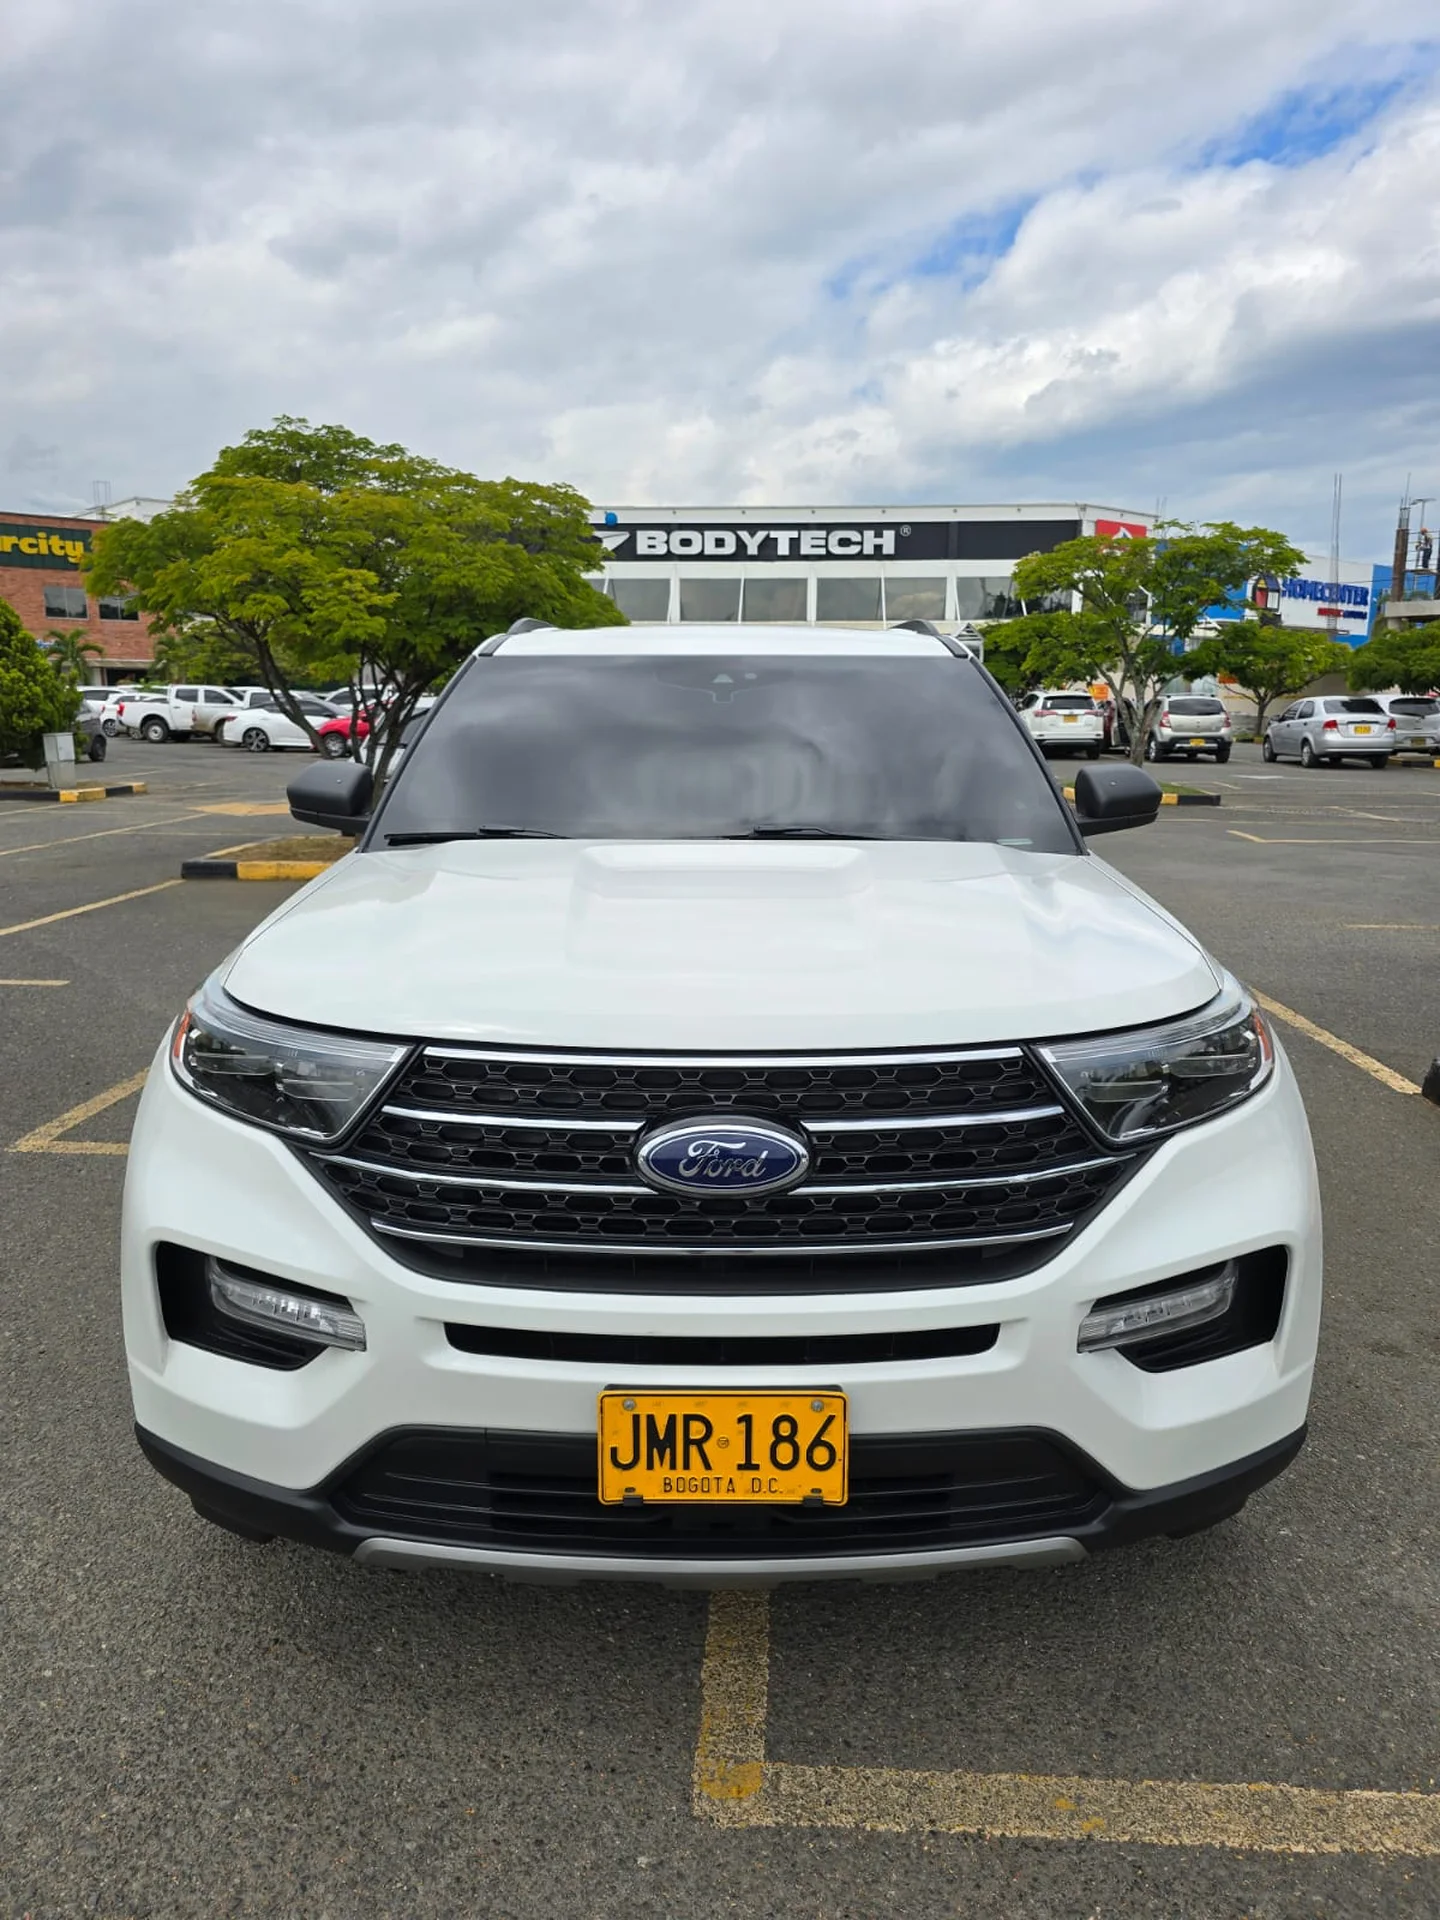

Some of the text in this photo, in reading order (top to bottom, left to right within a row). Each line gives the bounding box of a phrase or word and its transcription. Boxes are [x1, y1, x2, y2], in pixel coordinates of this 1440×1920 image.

[0, 532, 84, 563] rcity
[636, 530, 895, 556] BODYTECH
[678, 1140, 769, 1177] Ford
[610, 1414, 837, 1471] JMR 186
[663, 1476, 783, 1494] BOGOTA D.C.
